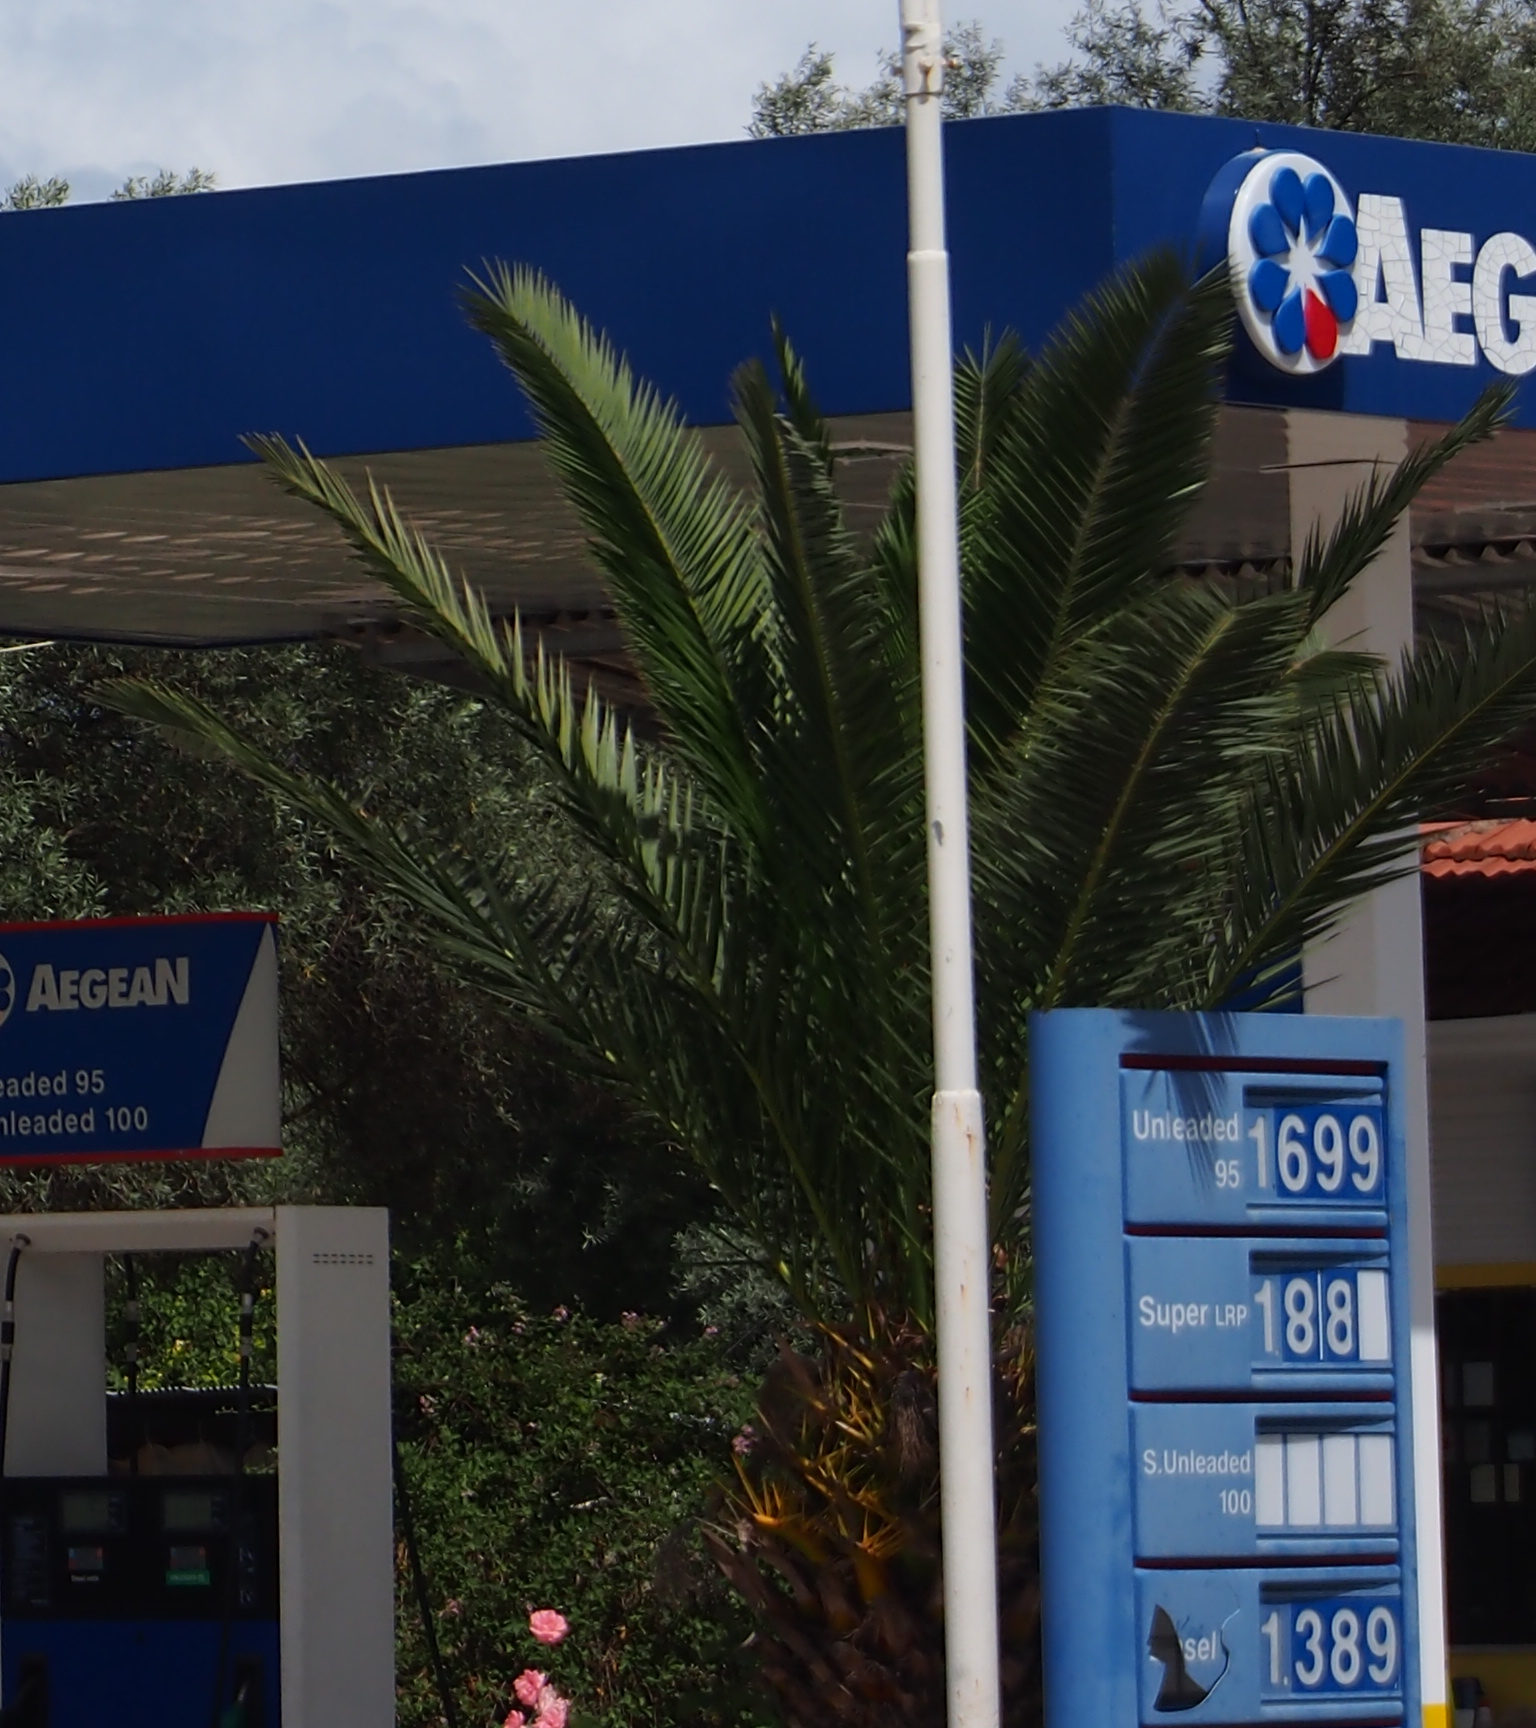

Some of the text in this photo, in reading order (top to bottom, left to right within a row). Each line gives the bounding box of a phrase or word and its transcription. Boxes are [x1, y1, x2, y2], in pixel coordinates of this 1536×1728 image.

[26, 957, 189, 1011] AEGEAN
[75, 1070, 105, 1095] 95
[105, 1106, 148, 1132] 100
[1132, 1109, 1239, 1141] Unleaded
[1248, 1113, 1379, 1192] 1699
[1214, 1159, 1240, 1188] 95
[1139, 1295, 1247, 1333] Super LRP
[1143, 1449, 1251, 1474] S.Unleaded
[1219, 1489, 1251, 1514] 100
